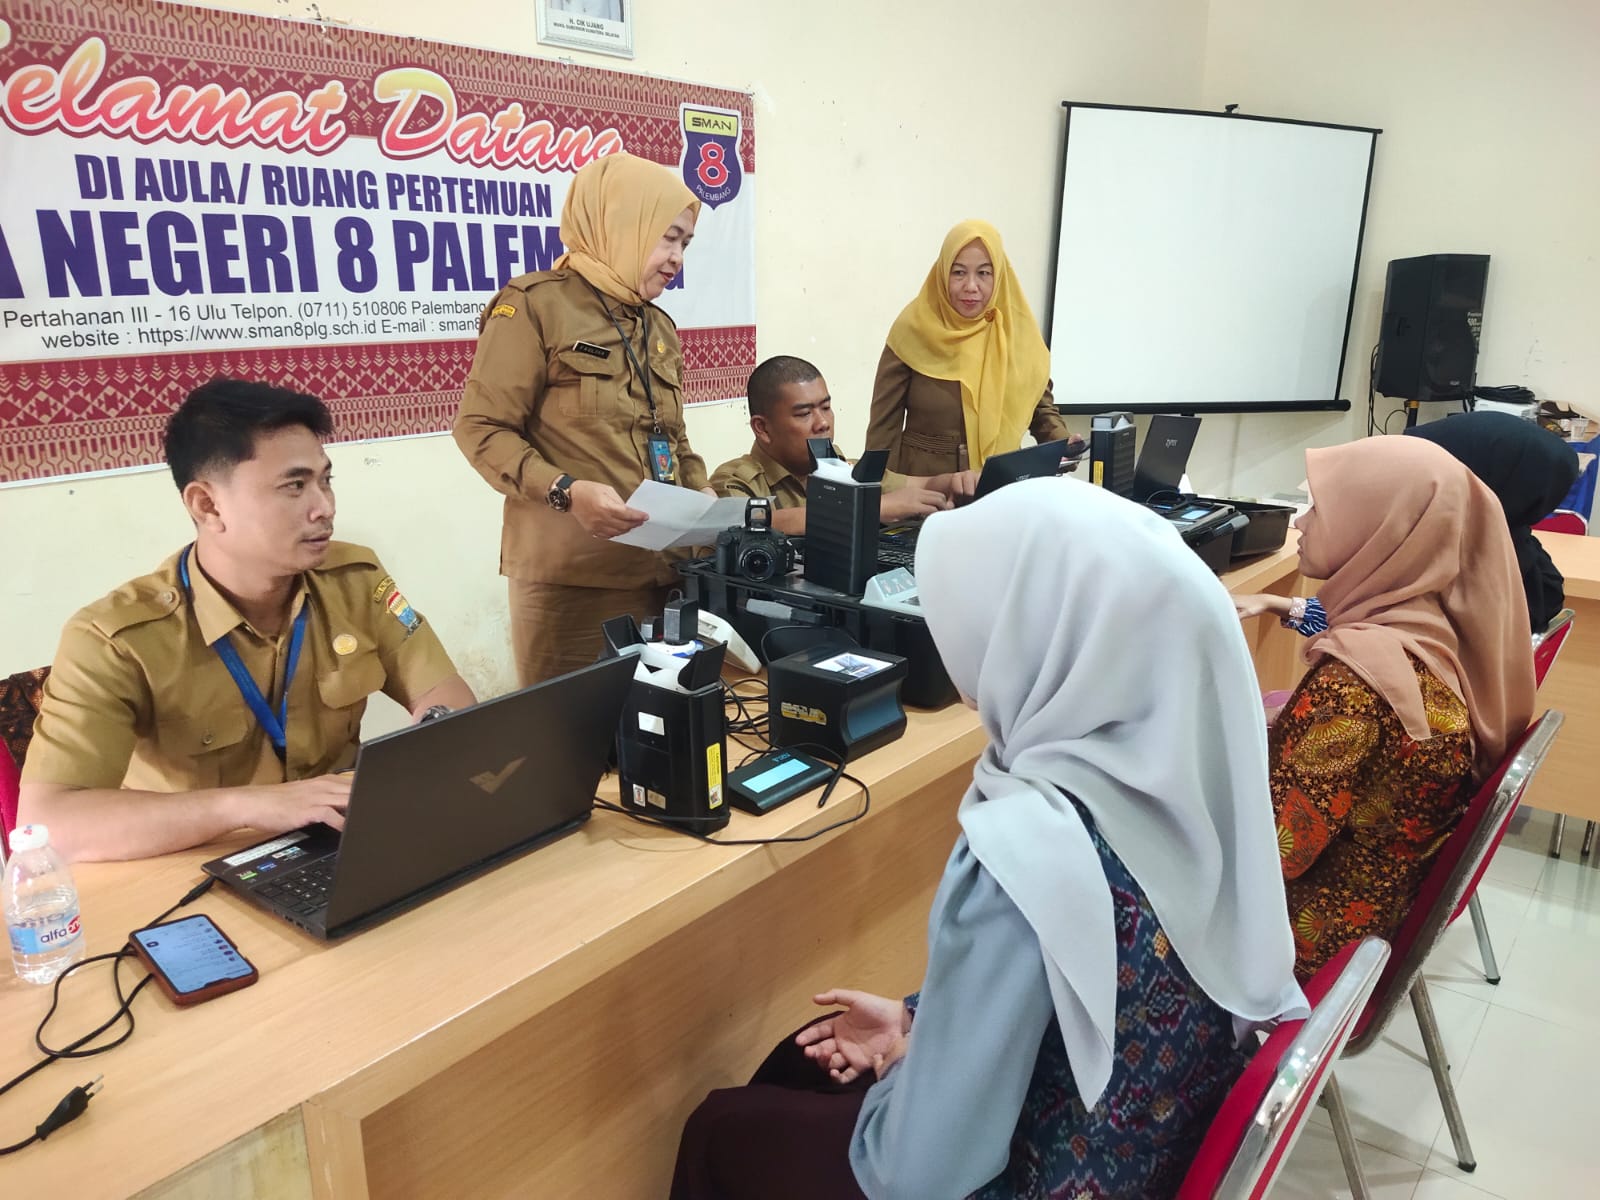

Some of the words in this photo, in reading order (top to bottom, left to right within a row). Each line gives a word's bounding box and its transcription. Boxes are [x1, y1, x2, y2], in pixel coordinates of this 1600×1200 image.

[587, 21, 605, 30] UJANG
[0, 19, 348, 155] elamat
[692, 116, 732, 131] SMAN
[697, 141, 729, 188] 8
[75, 154, 124, 200] DI
[135, 158, 251, 205] AULA/
[261, 164, 381, 210] RUANG
[386, 172, 553, 218] PERTEMUAN
[695, 184, 732, 201] PALEMBANG
[36, 209, 319, 298] NEGERI
[334, 216, 378, 294] 8
[4, 308, 125, 329] Pertahanan
[131, 306, 148, 323] III
[168, 305, 191, 322] 16
[197, 304, 227, 321] Ulu
[231, 302, 293, 323] Telpon.
[298, 301, 348, 320] (0711)
[352, 301, 408, 316] 510806
[42, 329, 120, 349] website
[138, 319, 377, 347] https://www.sman8plg.sch.id
[381, 318, 427, 334] E-mail
[41, 928, 68, 943] alfa
